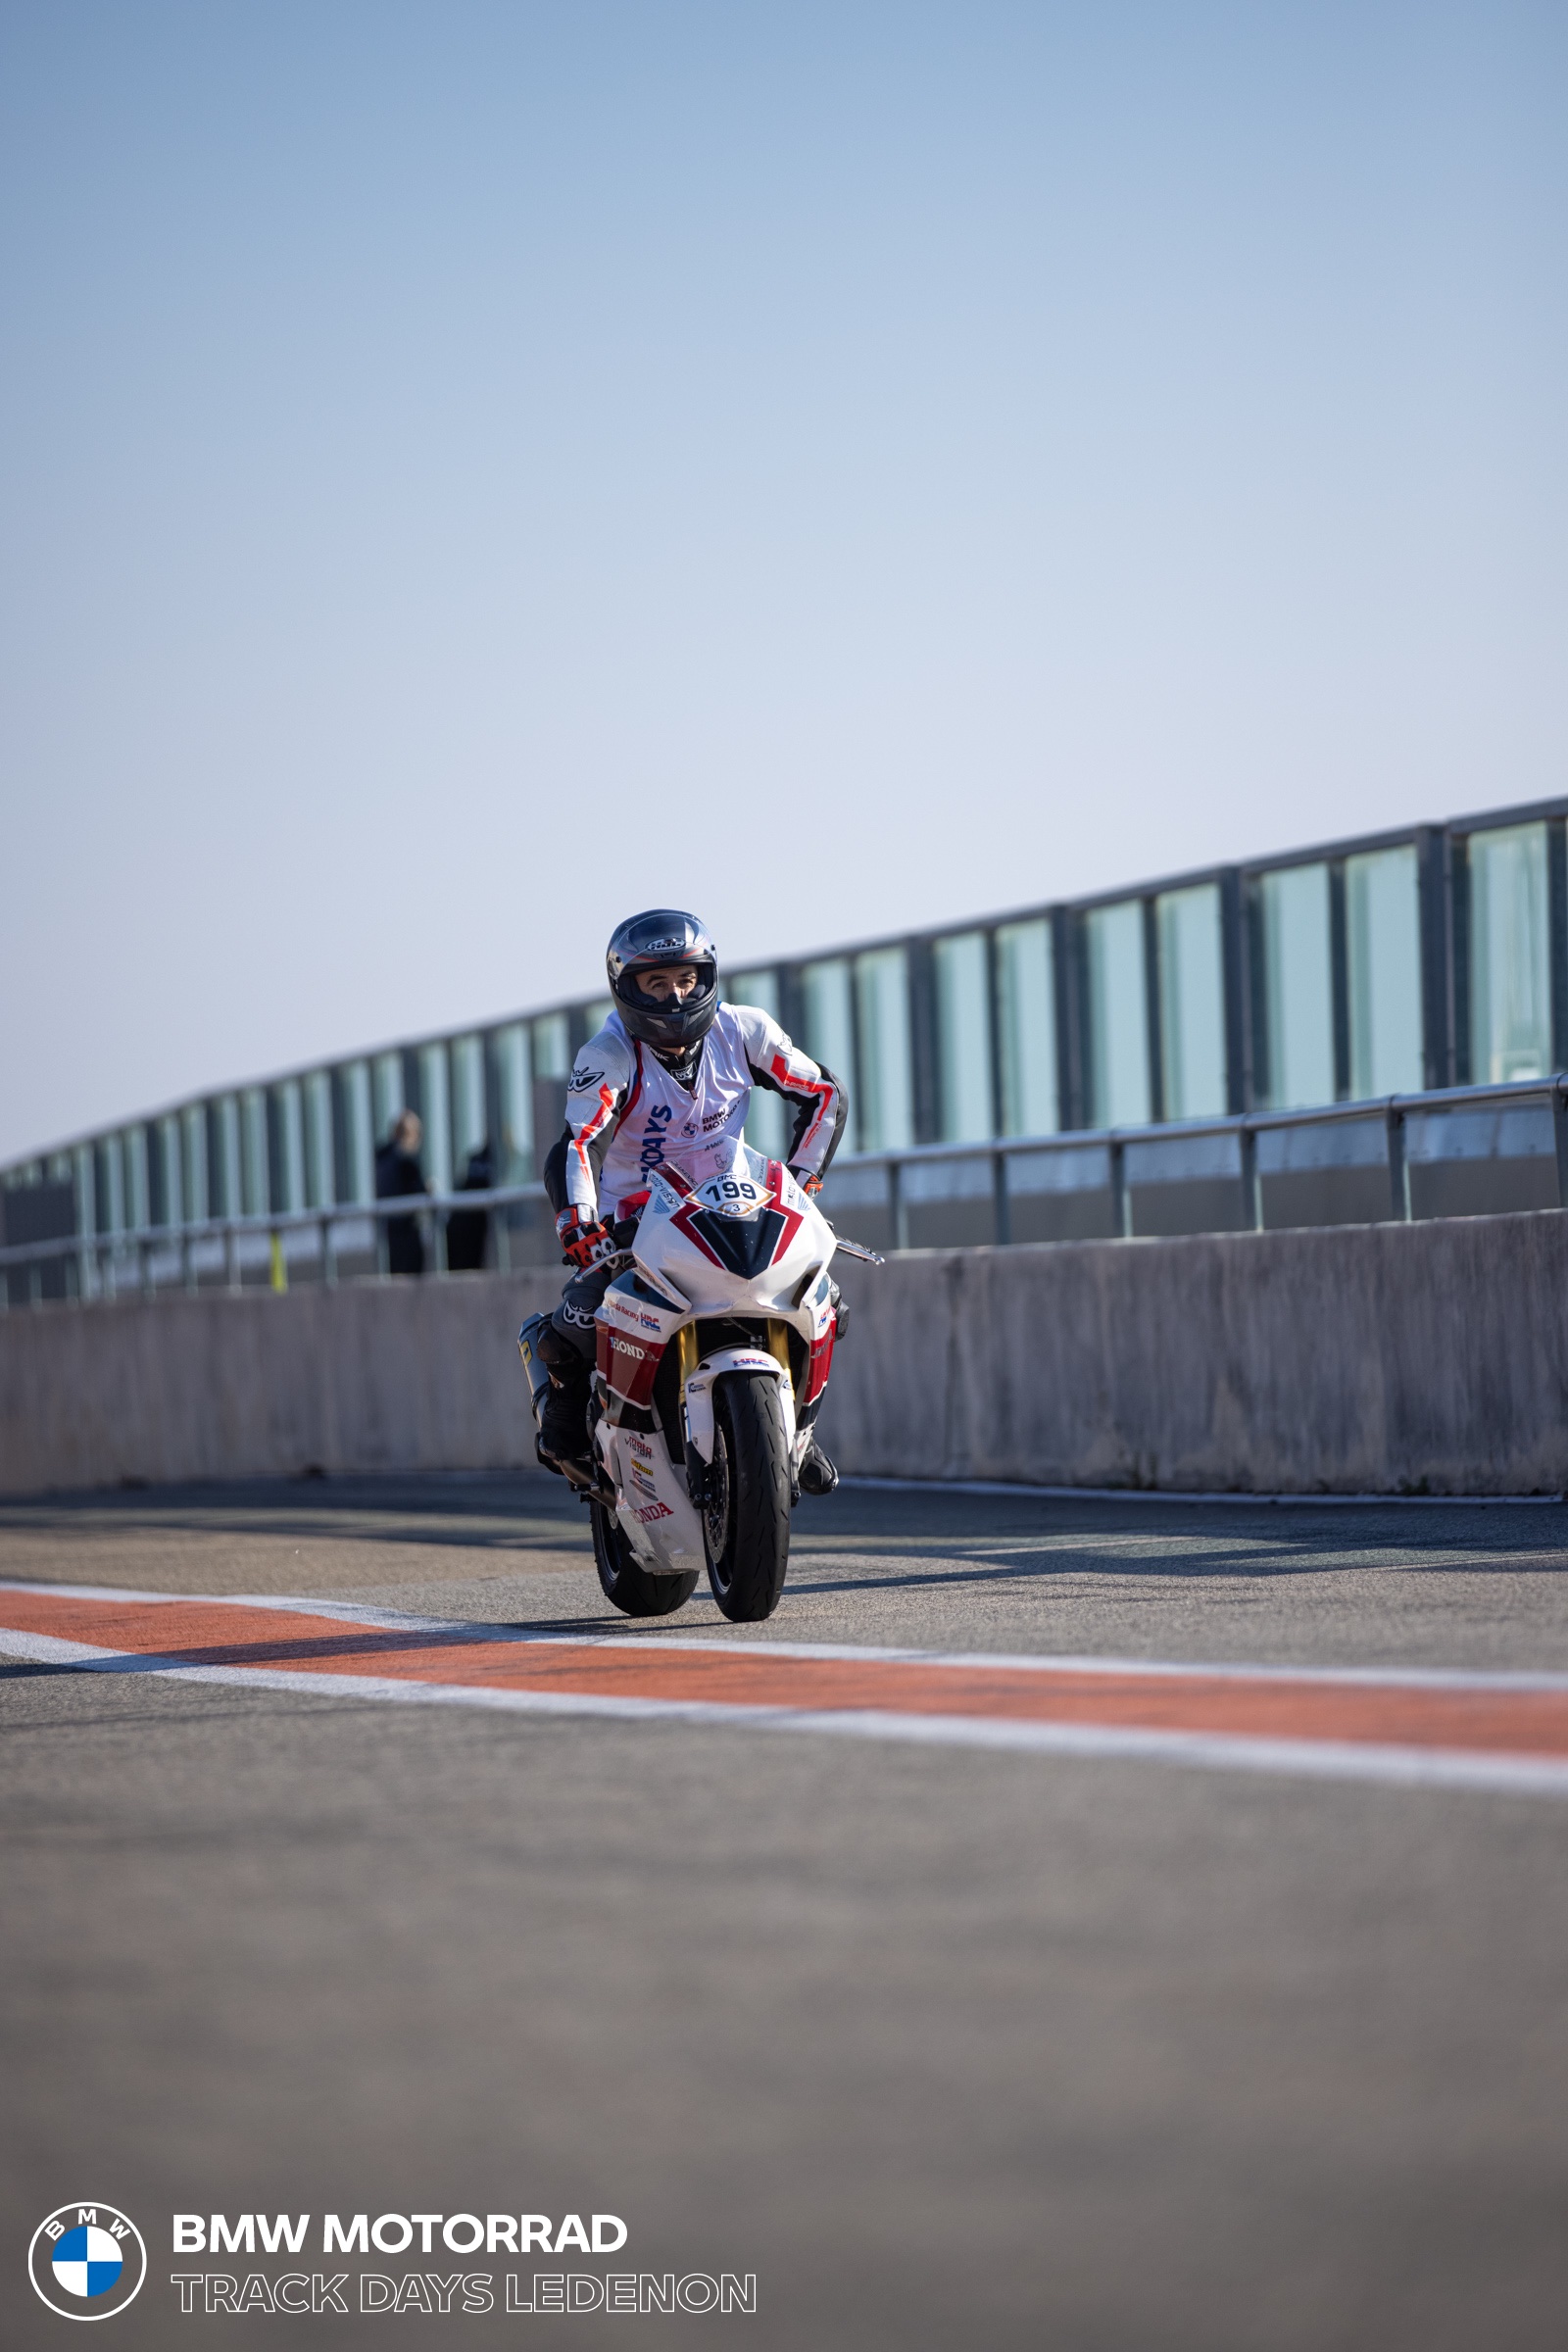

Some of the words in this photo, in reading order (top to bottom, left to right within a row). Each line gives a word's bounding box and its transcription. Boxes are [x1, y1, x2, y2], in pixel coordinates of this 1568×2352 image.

[702, 1108, 726, 1125] BMW
[706, 1181, 758, 1201] 199
[732, 1203, 741, 1212] 3
